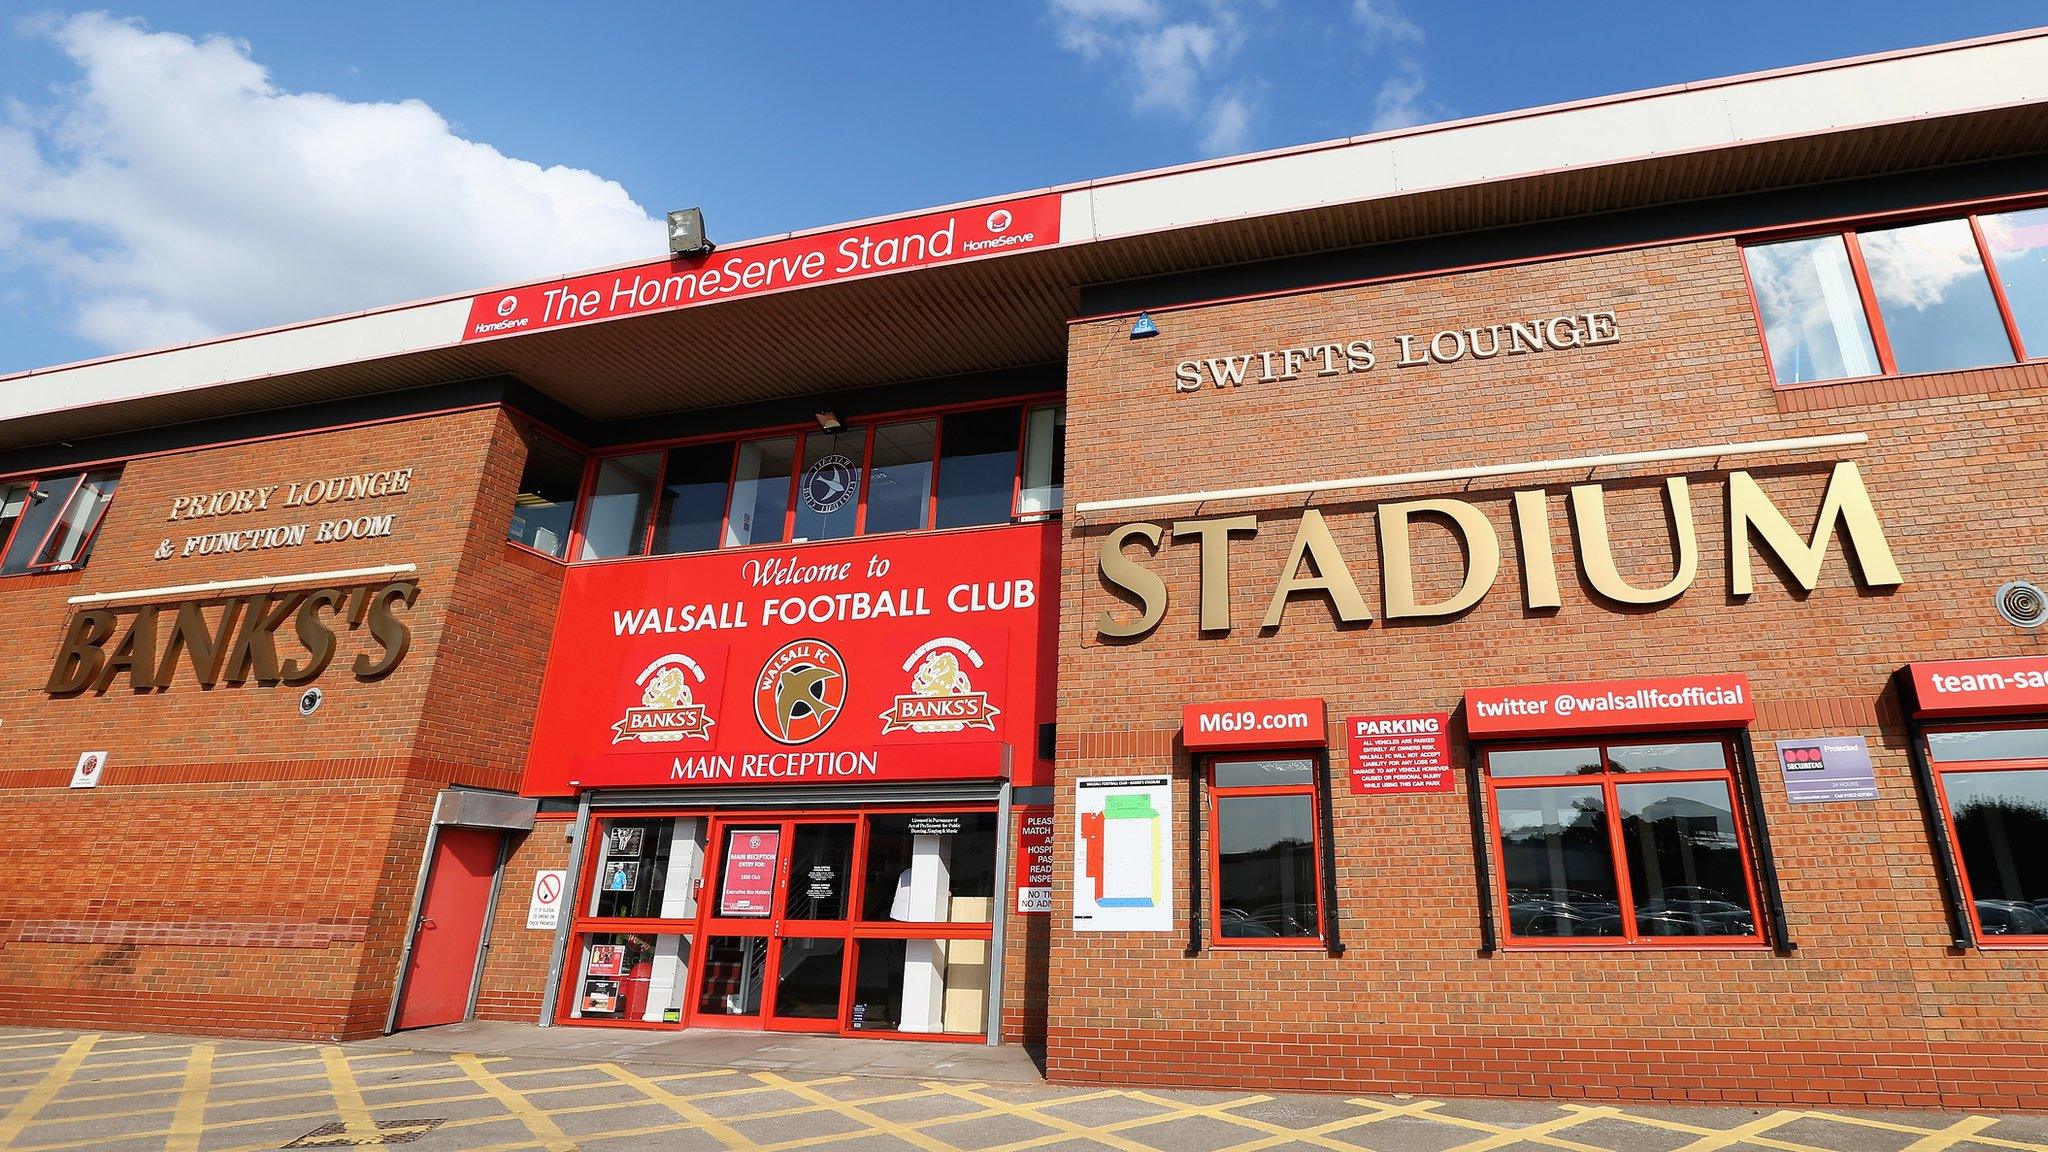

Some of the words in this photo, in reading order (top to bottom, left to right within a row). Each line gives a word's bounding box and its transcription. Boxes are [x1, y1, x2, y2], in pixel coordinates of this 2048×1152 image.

[963, 232, 1035, 252] HomeServe
[542, 286, 600, 324] The
[609, 248, 827, 313] HomeServe
[837, 216, 956, 275] Stand
[475, 318, 529, 334] HomeServe
[1175, 339, 1377, 393] SWIFTS
[1395, 310, 1620, 368] LOUNGE
[168, 484, 279, 522] PRIORY
[283, 467, 414, 509] LOUNGE
[154, 538, 175, 560] &
[181, 522, 309, 558] FUNCTION
[315, 513, 397, 544] ROOM
[1097, 461, 1904, 639] STADIUM
[742, 557, 852, 588] Welcome
[867, 552, 890, 578] to
[612, 602, 749, 637] WALSALL
[761, 587, 931, 627] FOOTBALL
[947, 578, 1037, 614] CLUB
[45, 580, 419, 698] BANKS'S
[761, 646, 811, 691] WALSALL
[813, 648, 830, 664] FC
[1931, 670, 2048, 693] team-sa
[901, 699, 979, 718] BANKS'S
[1476, 698, 1549, 718] twitter
[1554, 684, 1744, 715] @walsallfcofficial
[630, 711, 697, 729] BANKS'S
[1199, 710, 1309, 733] M6J9.com
[1356, 718, 1439, 735] PARKING
[1824, 744, 1859, 753] Protected
[670, 754, 735, 780] MAIN
[741, 751, 879, 778] RECEPTION
[1786, 761, 1824, 770] SECURITAS
[1022, 827, 1051, 835] MATCH
[1027, 846, 1053, 854] HOSPI
[1029, 875, 1052, 883] INSPE
[1030, 865, 1052, 873] READ
[1022, 900, 1033, 908] NO
[1028, 890, 1040, 899] NO
